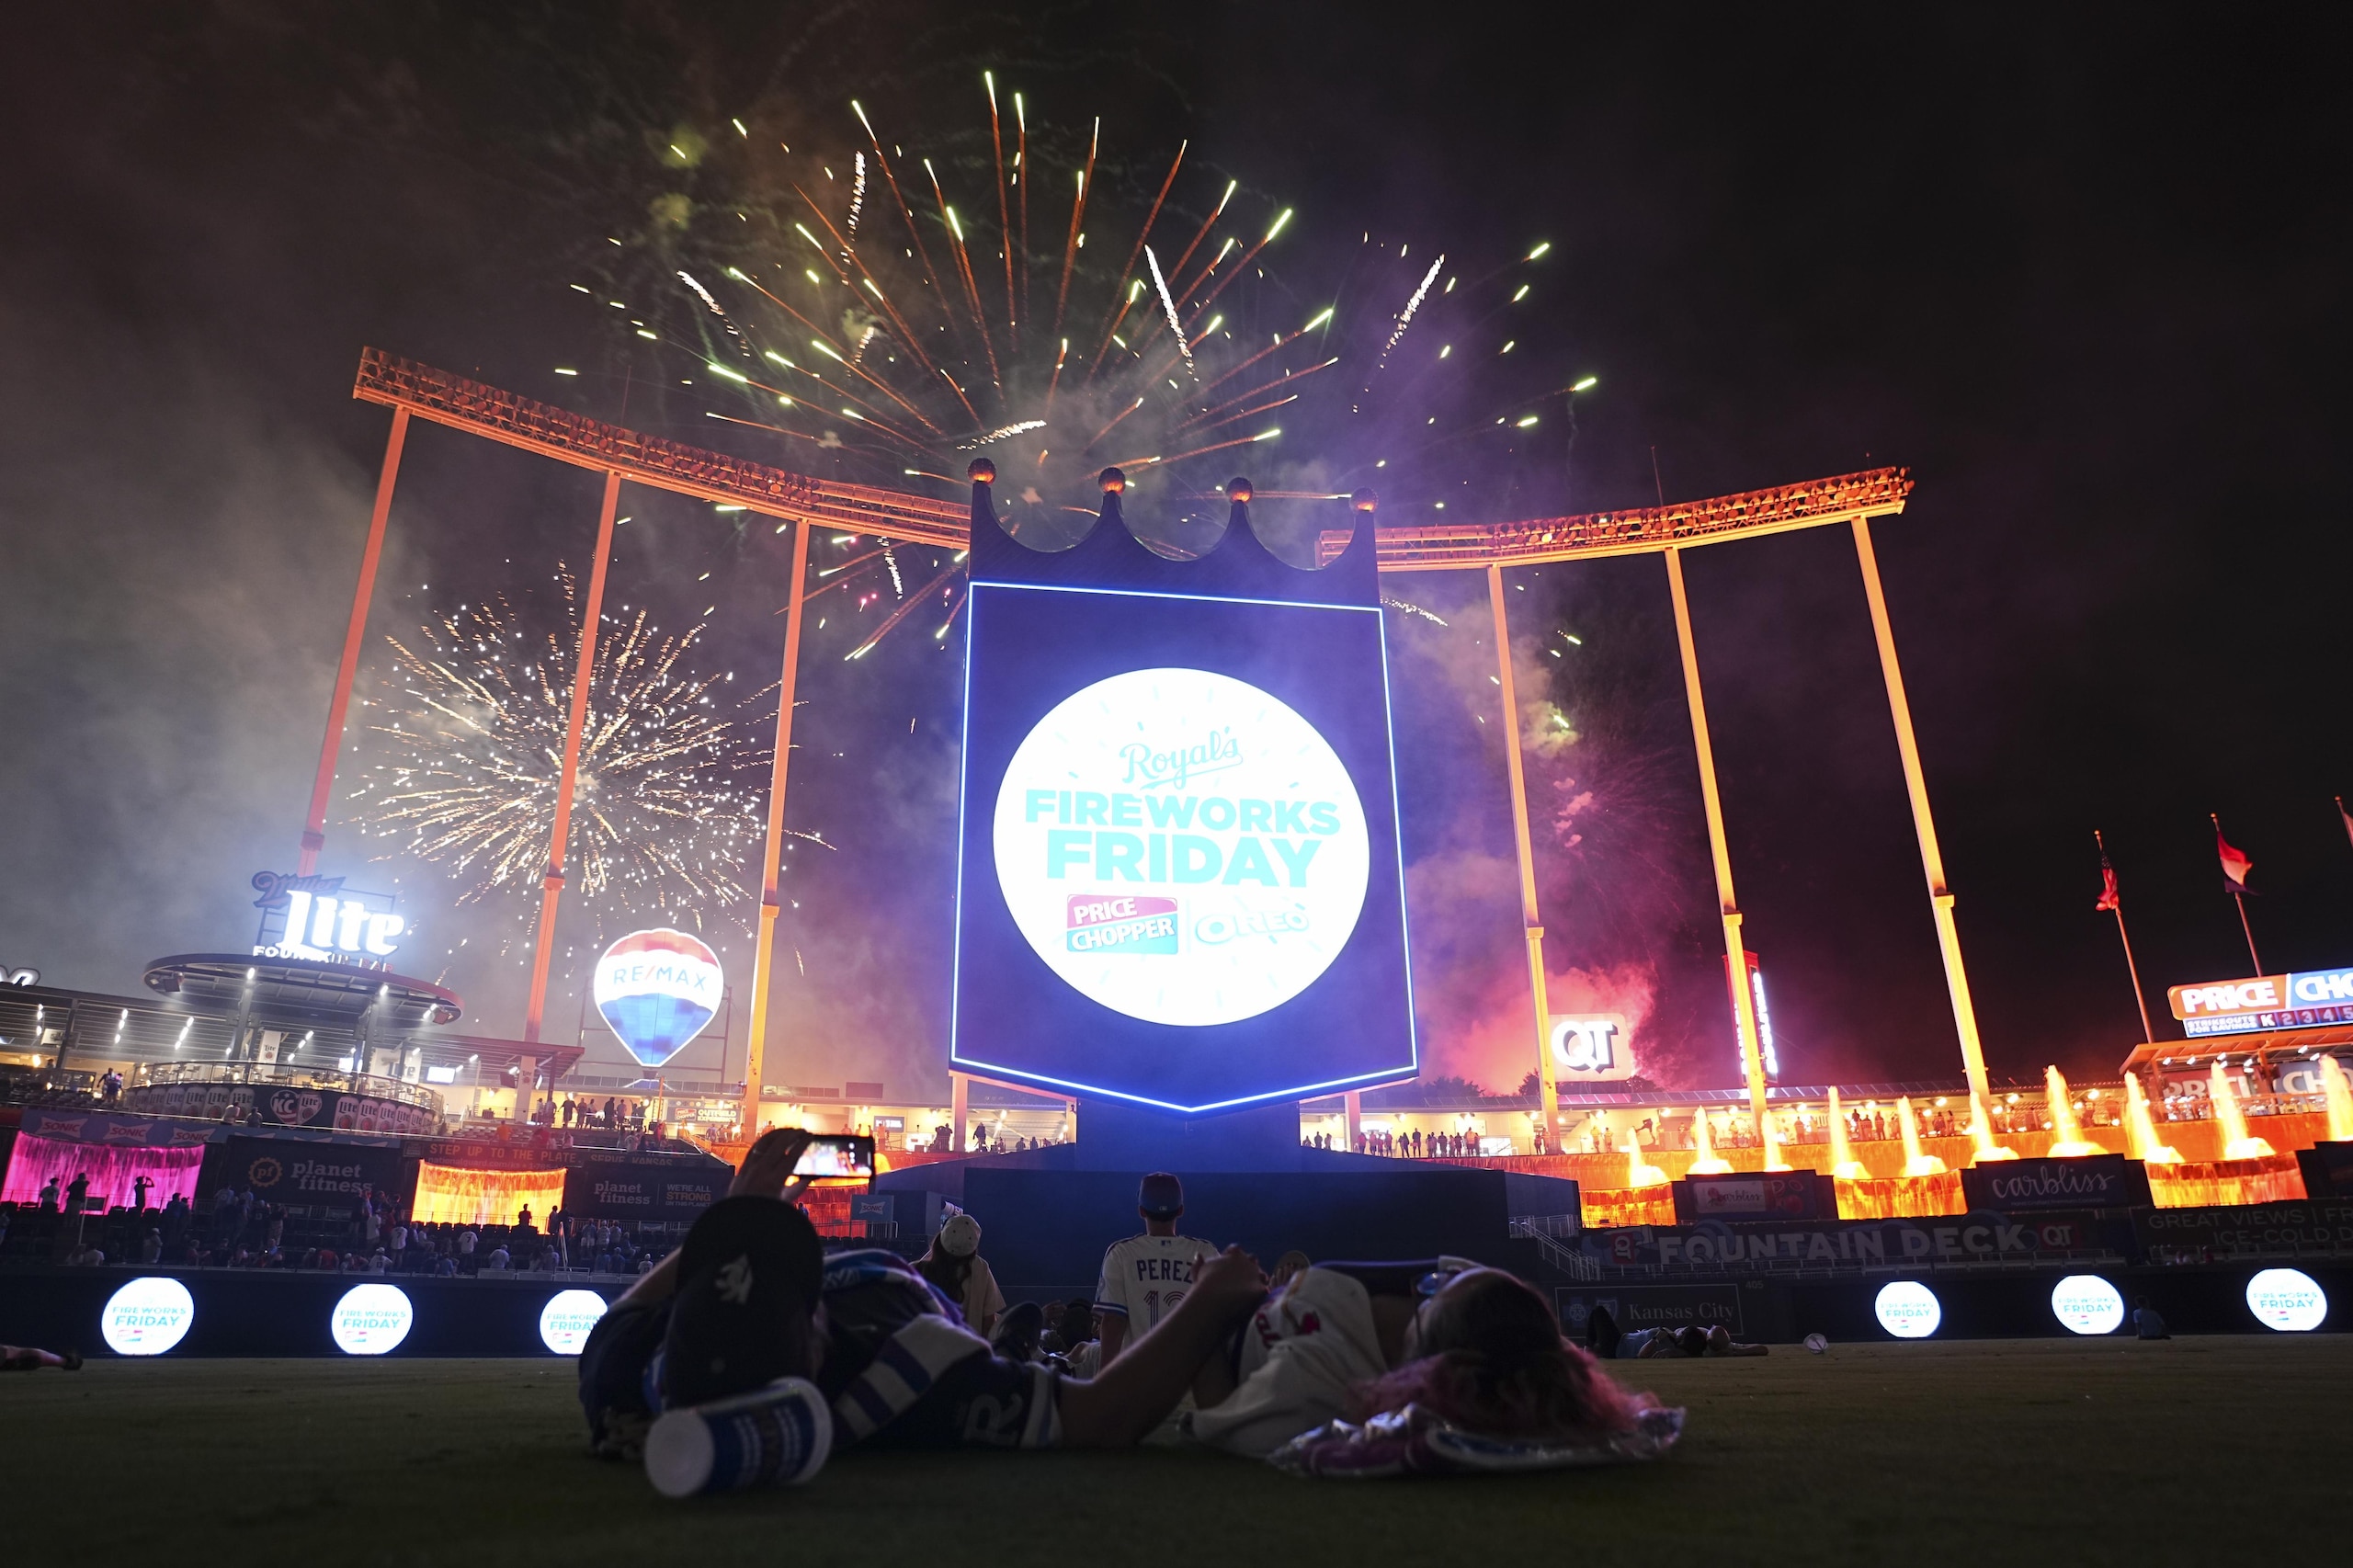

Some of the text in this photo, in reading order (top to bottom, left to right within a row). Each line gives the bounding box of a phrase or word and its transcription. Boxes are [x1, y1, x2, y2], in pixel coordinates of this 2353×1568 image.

[1025, 789, 1341, 835] FIREWORKS
[1047, 829, 1323, 888] FRIDAY
[1074, 897, 1139, 925] PRICE
[275, 890, 404, 956] Lite
[1196, 910, 1311, 946] OREO
[1071, 916, 1176, 951] CHOPPER
[614, 965, 707, 991] RE/MAX
[2181, 981, 2279, 1013] PRICE
[2187, 1015, 2256, 1028] STRIKEOUTS
[2259, 1014, 2276, 1027] K
[2281, 1006, 2353, 1026] 2 3 4 5
[2188, 1021, 2258, 1034] FOR SAVINGS
[1551, 1020, 1618, 1074] QT
[186, 1092, 205, 1105] Lite
[208, 1091, 227, 1105] Lite
[301, 1096, 319, 1107] Lite
[272, 1098, 294, 1113] KC
[338, 1101, 358, 1114] Lite
[359, 1104, 378, 1117] Lite
[380, 1107, 394, 1119] Lite
[42, 1121, 81, 1132] SONIC
[109, 1126, 147, 1137] SONIC
[173, 1131, 210, 1142] SONIC
[429, 1143, 461, 1155] STEP
[467, 1146, 483, 1156] UP
[491, 1147, 506, 1158] TO
[513, 1149, 534, 1160] THE
[631, 1156, 674, 1166] KANSAS
[290, 1160, 361, 1178] planet
[299, 1175, 373, 1193] fitness
[594, 1180, 642, 1195] planet
[666, 1183, 712, 1193] WE'RE ALL
[1991, 1164, 2116, 1199] carbliss
[599, 1191, 651, 1205] fitness
[665, 1191, 711, 1202] STRONG
[1721, 1189, 1765, 1203] arbliss
[2149, 1212, 2222, 1229] GREAT
[2229, 1209, 2305, 1225] VIEWS
[2041, 1224, 2074, 1247] QT
[2213, 1228, 2331, 1245] ICE-COLD
[1614, 1234, 1632, 1261] QT
[1659, 1223, 2026, 1265] FOUNTAIN DECK
[1136, 1258, 1194, 1285] PEREZ
[1745, 1279, 1764, 1290] 405
[112, 1306, 187, 1314] FIREWORKS
[2063, 1304, 2112, 1312] FRIDAY
[2260, 1299, 2314, 1308] FRIDAY
[339, 1310, 406, 1318] FIREWORKS
[1629, 1301, 1734, 1323] Kansas City
[1885, 1309, 1930, 1317] FRIDAY
[115, 1315, 179, 1326] FRIDAY
[343, 1318, 400, 1328] FRIDAY
[550, 1321, 597, 1331] FRIDA
